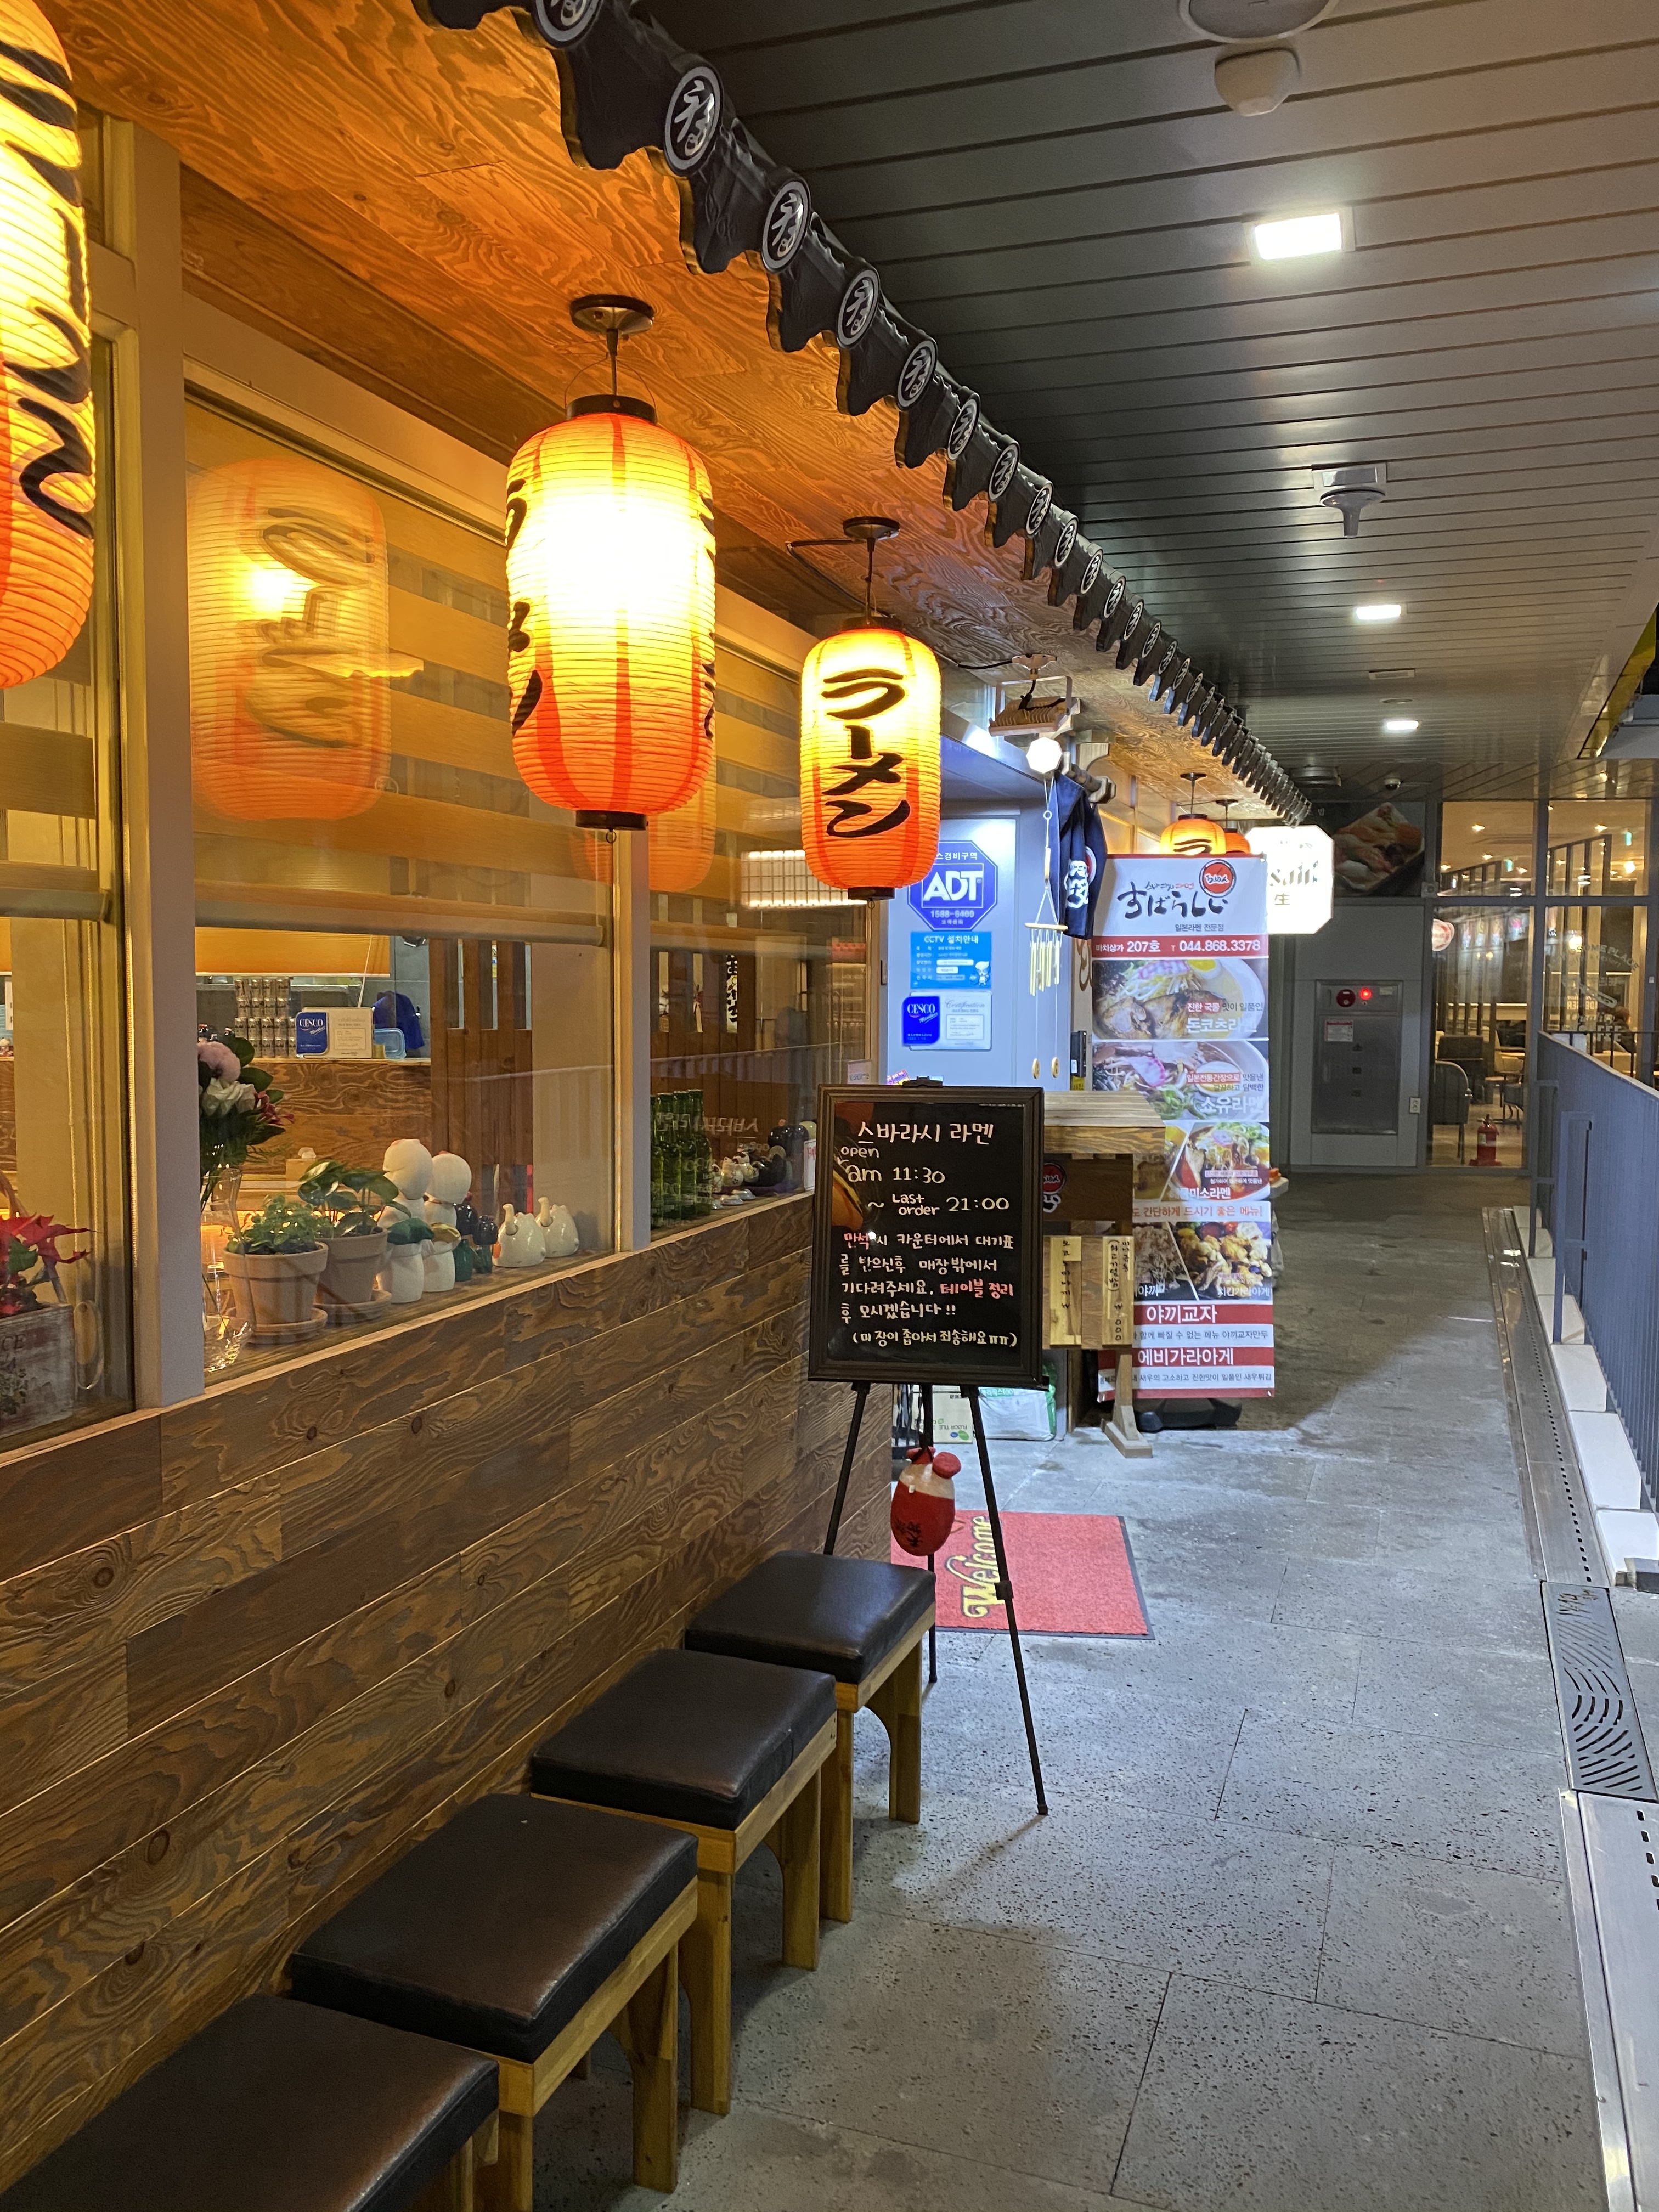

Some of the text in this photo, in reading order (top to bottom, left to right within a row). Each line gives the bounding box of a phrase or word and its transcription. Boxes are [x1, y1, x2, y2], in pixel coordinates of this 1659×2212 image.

[821, 669, 911, 839] ラーメン
[936, 852, 978, 860] 스경비구역
[923, 871, 983, 901] ADT
[1117, 881, 1228, 919] すばらしい
[1175, 924, 1224, 932] 일본라멘 전문점
[947, 935, 979, 944] 설치안내
[1127, 940, 1161, 953] 207호
[1179, 939, 1261, 952] 044.868.3378
[907, 1003, 935, 1014] CESCO
[1204, 1002, 1220, 1012] 국물
[1240, 1002, 1263, 1012] 일품인
[299, 1018, 323, 1028] CESCO
[1243, 1084, 1264, 1092] 담백한
[1200, 1097, 1265, 1114] 쇼유라멘
[858, 1121, 994, 1146] 스바라시 라멘
[840, 1146, 880, 1158] open
[847, 1165, 946, 1184] am 11:30
[892, 1193, 925, 1204] Last
[946, 1197, 1010, 1212] 21:00
[898, 1204, 940, 1216] order
[1143, 1207, 1180, 1217] 간단하게
[1184, 1206, 1212, 1217] 드시기
[844, 1233, 1014, 1250] 만석 시 카운터에서 대기표
[839, 1254, 850, 1276] 를
[842, 1278, 1014, 1299] 기다려주세요. 테이블 정리
[841, 1302, 851, 1324] 후
[1146, 1305, 1218, 1324] 야끼교자
[902, 1328, 936, 1346] 좁아서
[1158, 1330, 1172, 1339] 빠질
[1186, 1330, 1201, 1339] 없는
[1204, 1331, 1220, 1339] 메뉴
[1222, 1330, 1269, 1339] 야끼교자만두
[1137, 1347, 1234, 1366] 에비가라아게
[1140, 1373, 1160, 1382] 새우의
[1192, 1373, 1219, 1381] 진한맛이
[1221, 1373, 1242, 1381] 일품인
[1244, 1373, 1272, 1381] 새우튀김
[945, 1515, 1006, 1618] Welcome
